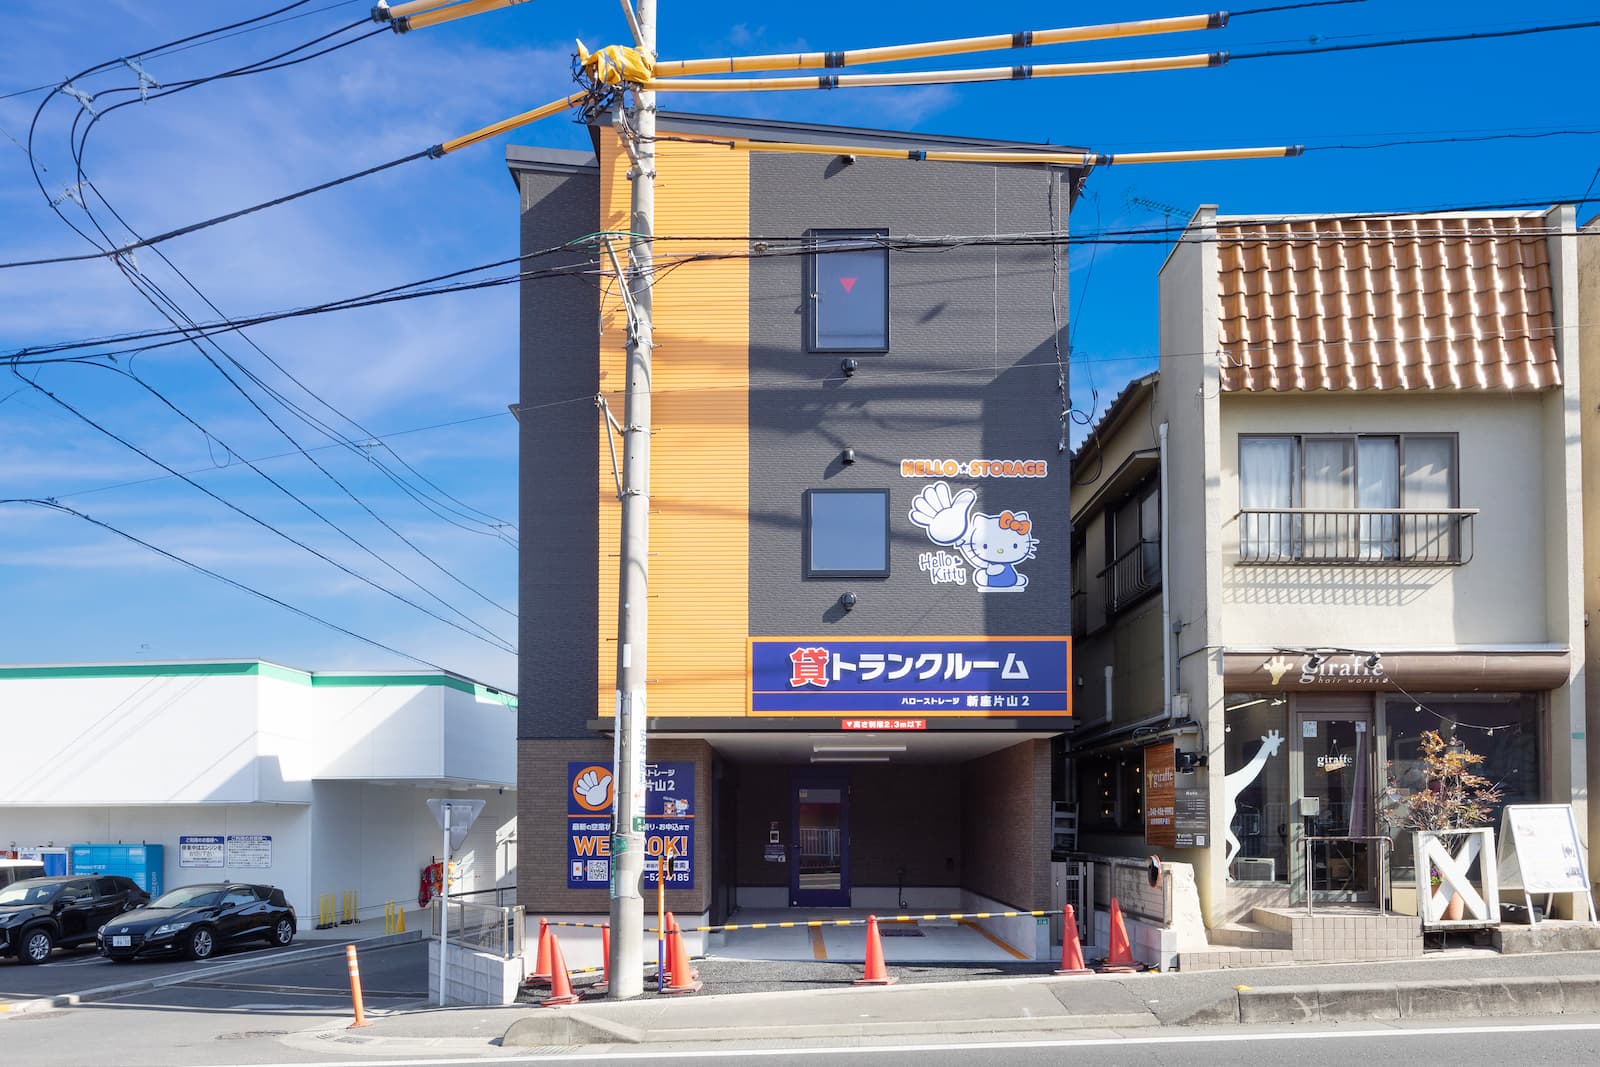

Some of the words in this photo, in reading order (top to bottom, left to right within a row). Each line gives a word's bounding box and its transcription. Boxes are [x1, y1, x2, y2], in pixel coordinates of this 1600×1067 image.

[901, 460, 959, 476] HELLO
[969, 460, 1047, 476] STORAGE
[920, 552, 953, 569] Hello
[931, 567, 965, 583] Kitty
[789, 647, 1030, 688] 貸トランクルーム
[1348, 676, 1380, 684] works
[901, 697, 960, 705] ハローストレージ
[1317, 754, 1352, 768] giraffe
[573, 836, 611, 857] WE
